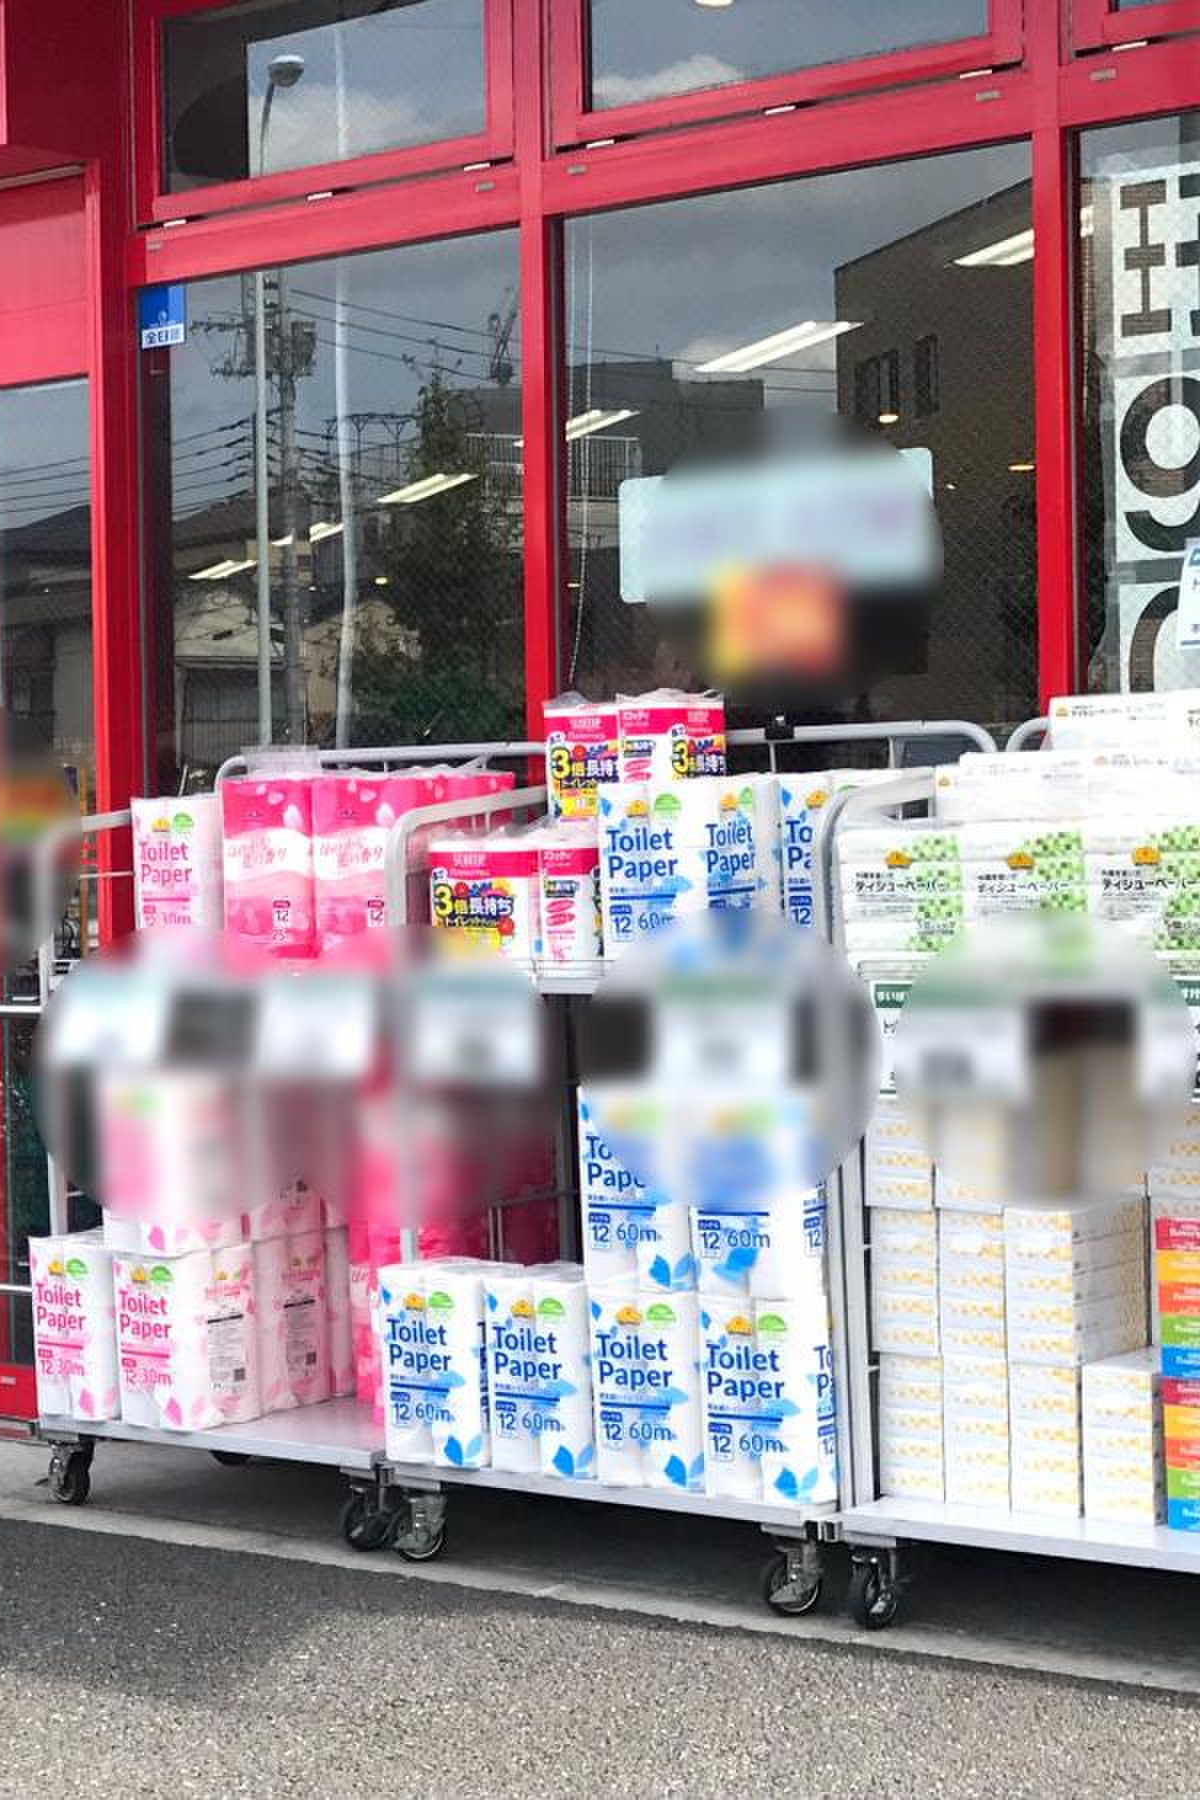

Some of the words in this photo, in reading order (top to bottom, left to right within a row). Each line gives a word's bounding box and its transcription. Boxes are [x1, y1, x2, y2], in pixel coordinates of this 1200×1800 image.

[606, 827, 674, 853] Toilet
[706, 822, 753, 848] Toilet
[139, 841, 189, 862] Toilet
[707, 848, 755, 876] Paper
[141, 864, 192, 884] Paper
[608, 856, 679, 883] Paper
[613, 917, 632, 934] 12
[793, 908, 812, 925] 12
[591, 1225, 609, 1243] 12
[702, 1233, 720, 1251] 12
[727, 1230, 771, 1249] 60m
[35, 1282, 81, 1307] Toilet
[118, 1290, 168, 1315] Toilet
[36, 1306, 87, 1332] Paper
[119, 1313, 173, 1340] Paper
[386, 1317, 447, 1346] Toilet
[492, 1325, 558, 1355] Toilet
[595, 1333, 669, 1361] Toilet
[390, 1343, 452, 1374] Paper
[494, 1352, 563, 1382] Paper
[705, 1343, 780, 1372] Toilet
[599, 1361, 673, 1391] Paper
[706, 1371, 785, 1402] Paper
[394, 1402, 411, 1421] 12
[499, 1413, 516, 1431] 12
[604, 1423, 622, 1441] 12
[712, 1435, 732, 1454] 12
[738, 1433, 785, 1453] 60m
